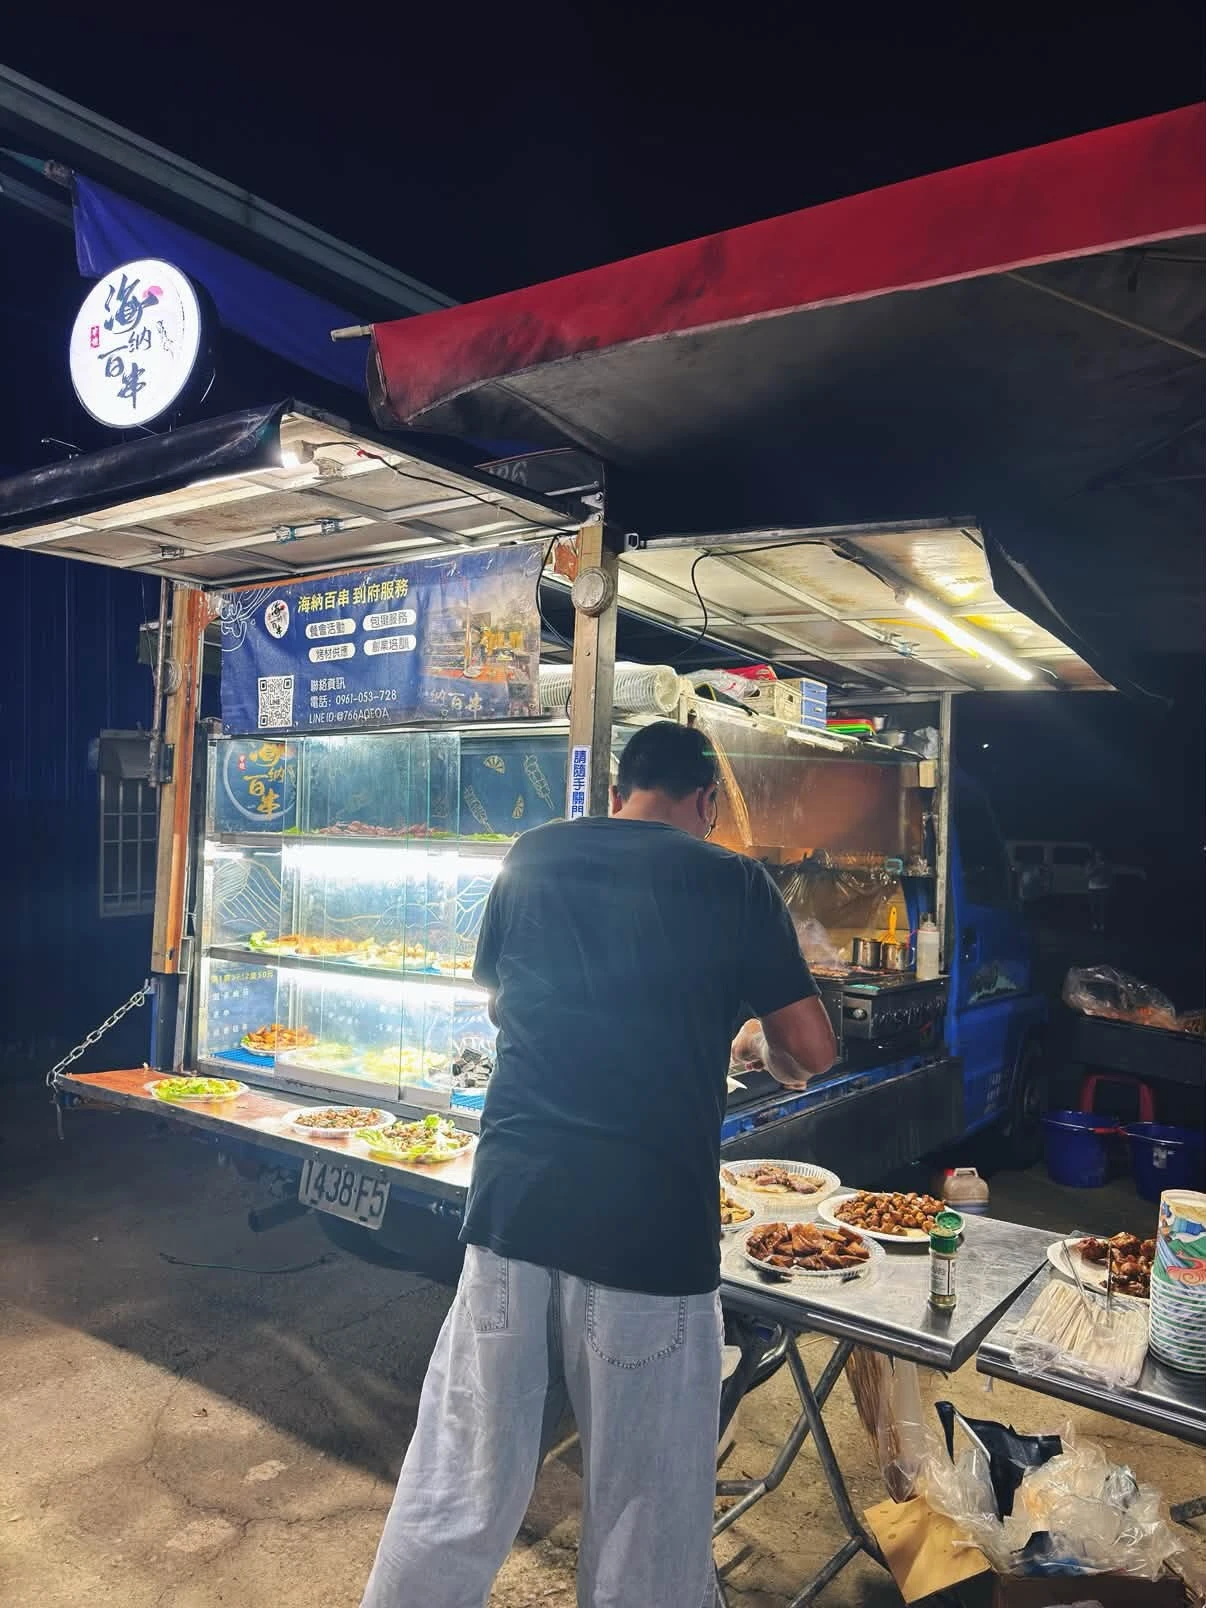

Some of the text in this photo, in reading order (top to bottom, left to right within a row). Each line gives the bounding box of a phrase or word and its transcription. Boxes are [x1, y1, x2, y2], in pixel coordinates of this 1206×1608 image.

[297, 578, 409, 614] 海納百串 到府服務
[310, 677, 346, 692] 聯絡資訊
[335, 689, 398, 706] 0961-053-728
[571, 750, 587, 818] 請隨手關門
